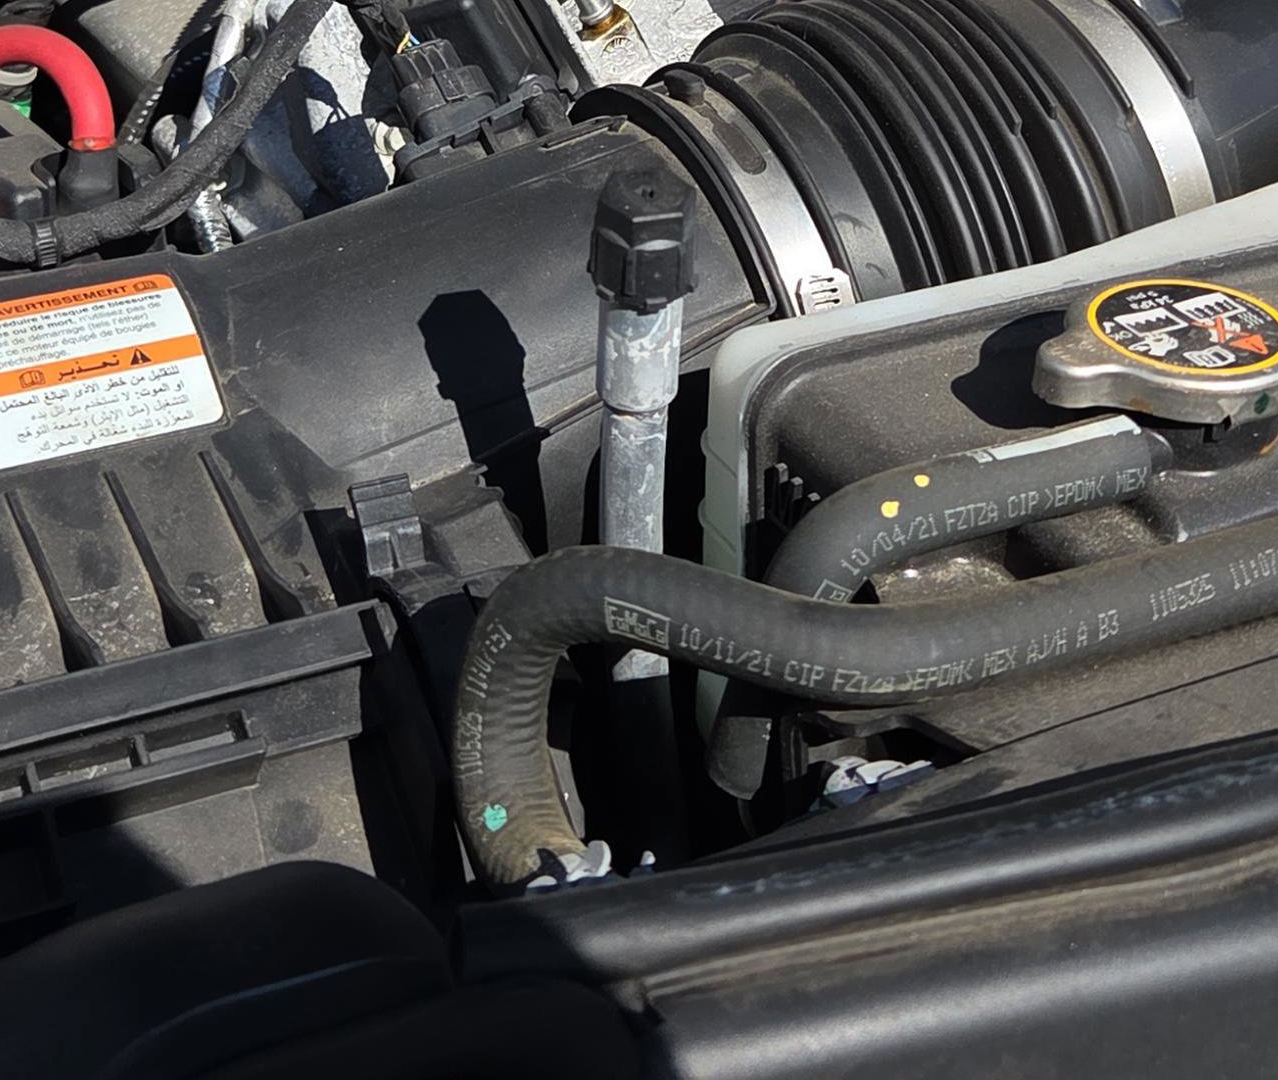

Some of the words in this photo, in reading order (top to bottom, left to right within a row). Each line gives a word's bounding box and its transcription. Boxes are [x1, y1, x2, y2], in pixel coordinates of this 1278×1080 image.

[12, 328, 27, 336] ou
[30, 323, 44, 332] de
[126, 305, 145, 314] pas
[54, 307, 89, 318] risque
[91, 304, 106, 312] de
[108, 294, 162, 308] blessures
[5, 349, 19, 357] ce
[22, 340, 59, 353] moteur
[99, 329, 114, 338] de
[115, 321, 157, 334] bougies
[11, 338, 25, 346] de
[58, 354, 120, 381] تحذير
[841, 513, 940, 577] 10/04/21
[1007, 491, 1040, 519] CIP
[1113, 467, 1149, 496] MEX
[679, 623, 773, 677] 10/11/21
[784, 660, 825, 688] CIP
[982, 646, 1019, 678] MEX
